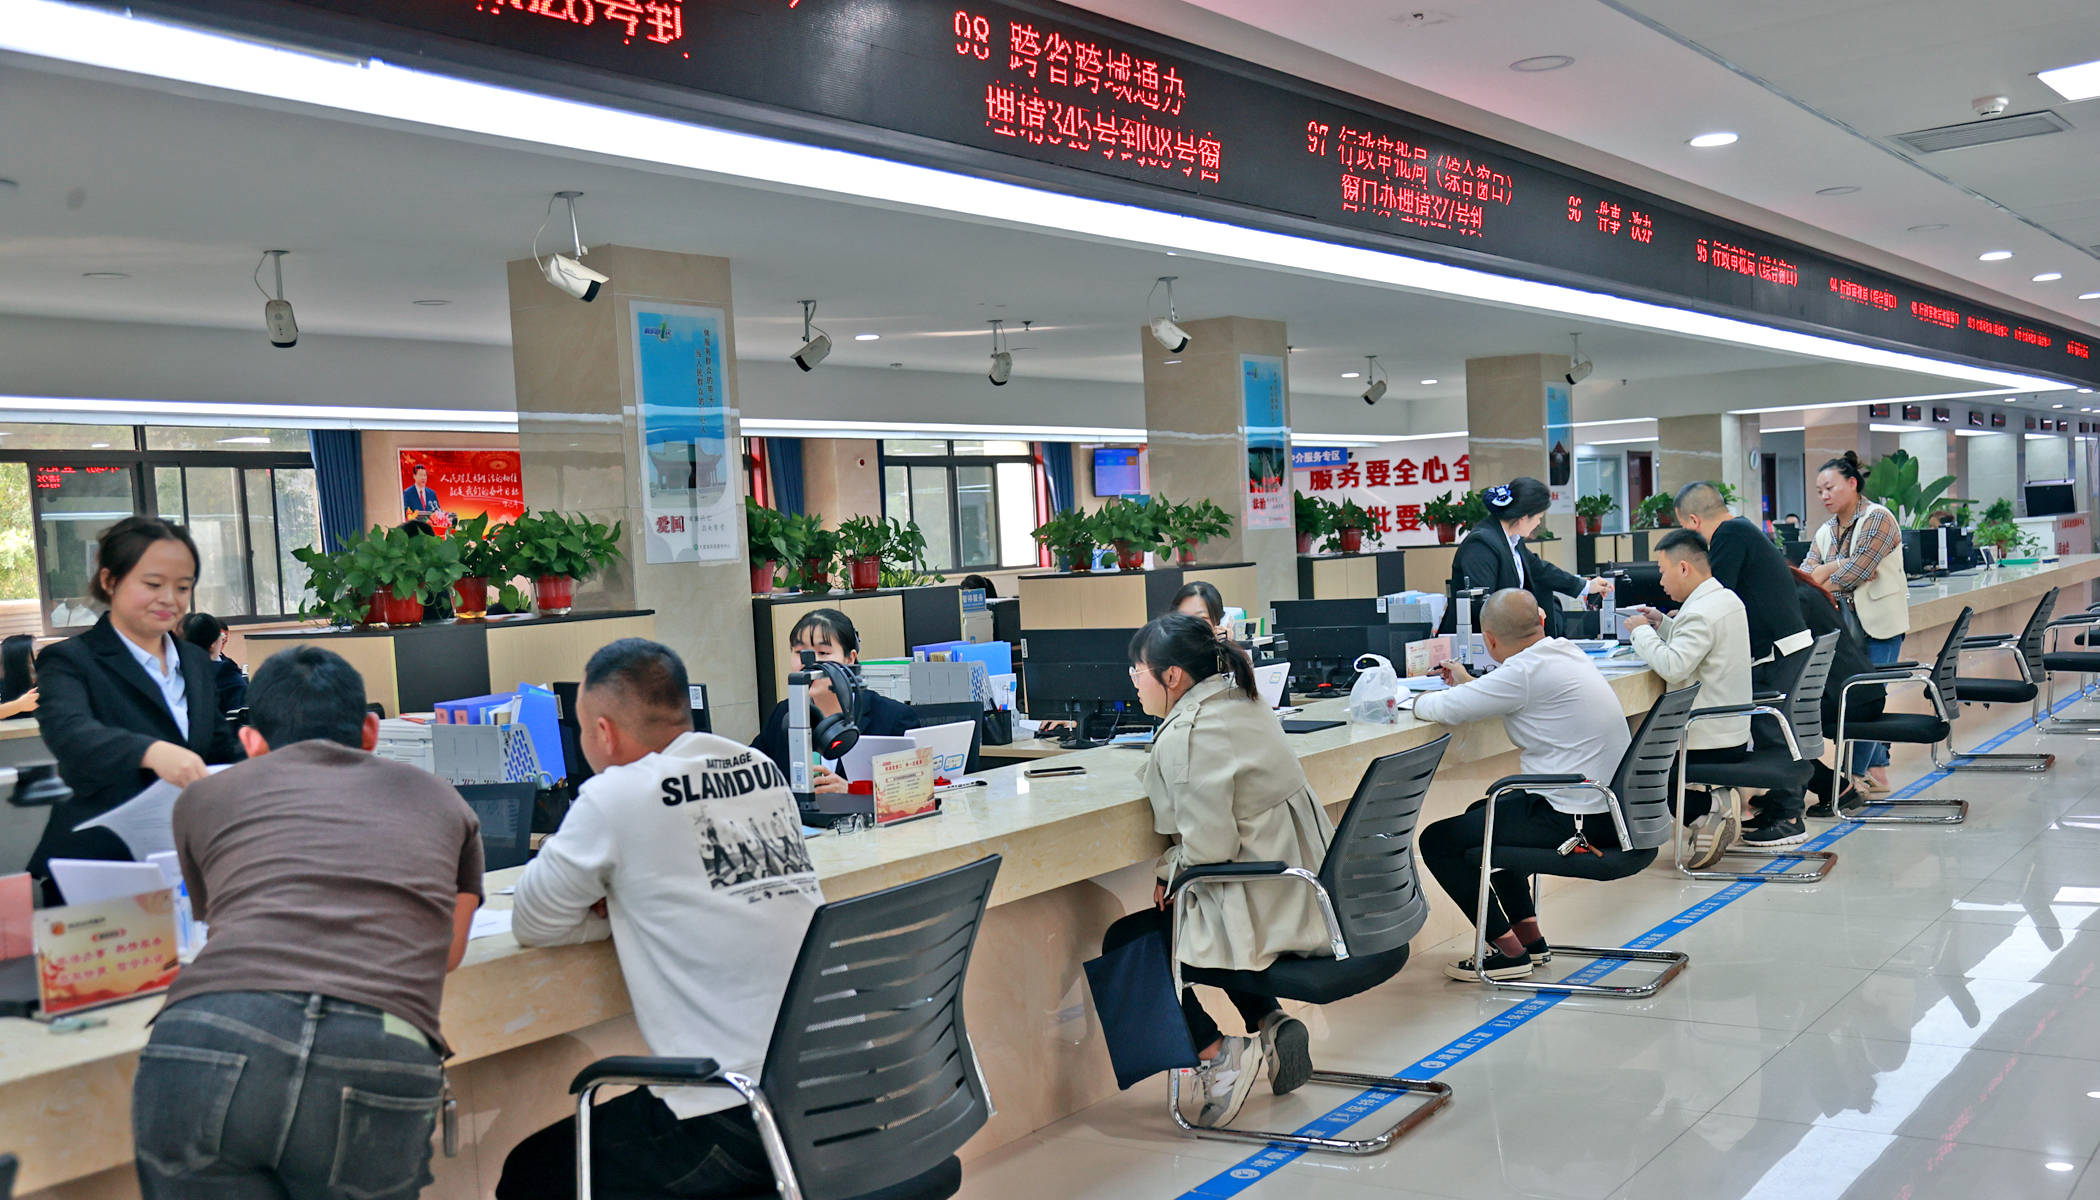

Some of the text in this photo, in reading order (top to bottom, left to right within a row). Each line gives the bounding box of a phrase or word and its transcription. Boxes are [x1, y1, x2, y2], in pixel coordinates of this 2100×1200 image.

[955, 10, 1188, 116] 98 跨省跨域通办
[656, 515, 685, 534] 爱国
[1367, 503, 1437, 533] 批要
